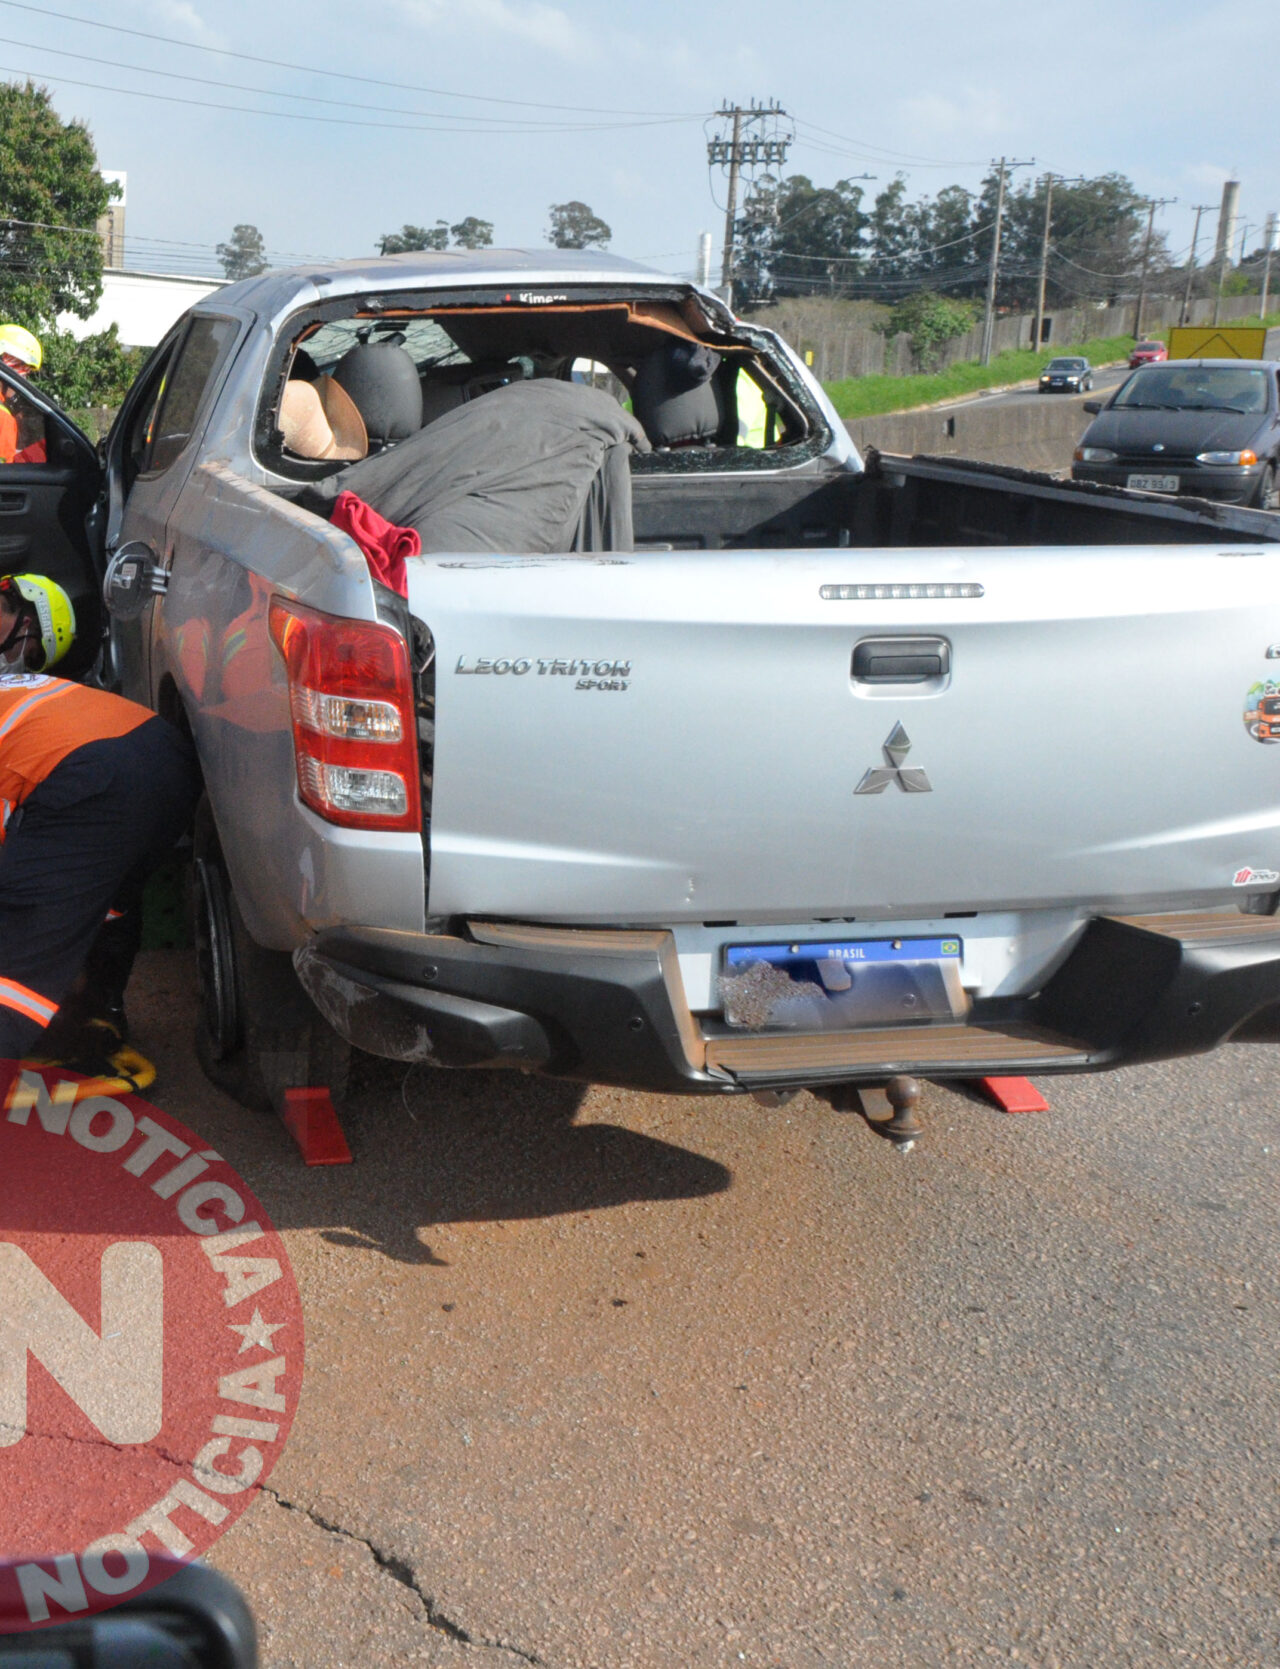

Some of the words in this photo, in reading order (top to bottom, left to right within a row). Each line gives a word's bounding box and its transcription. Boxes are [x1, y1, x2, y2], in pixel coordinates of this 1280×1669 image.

[38, 594, 52, 637] RESGATE
[454, 655, 532, 676] L200
[536, 657, 632, 677] TRITON
[574, 679, 632, 691] SPORT
[827, 948, 866, 960] BRASIL
